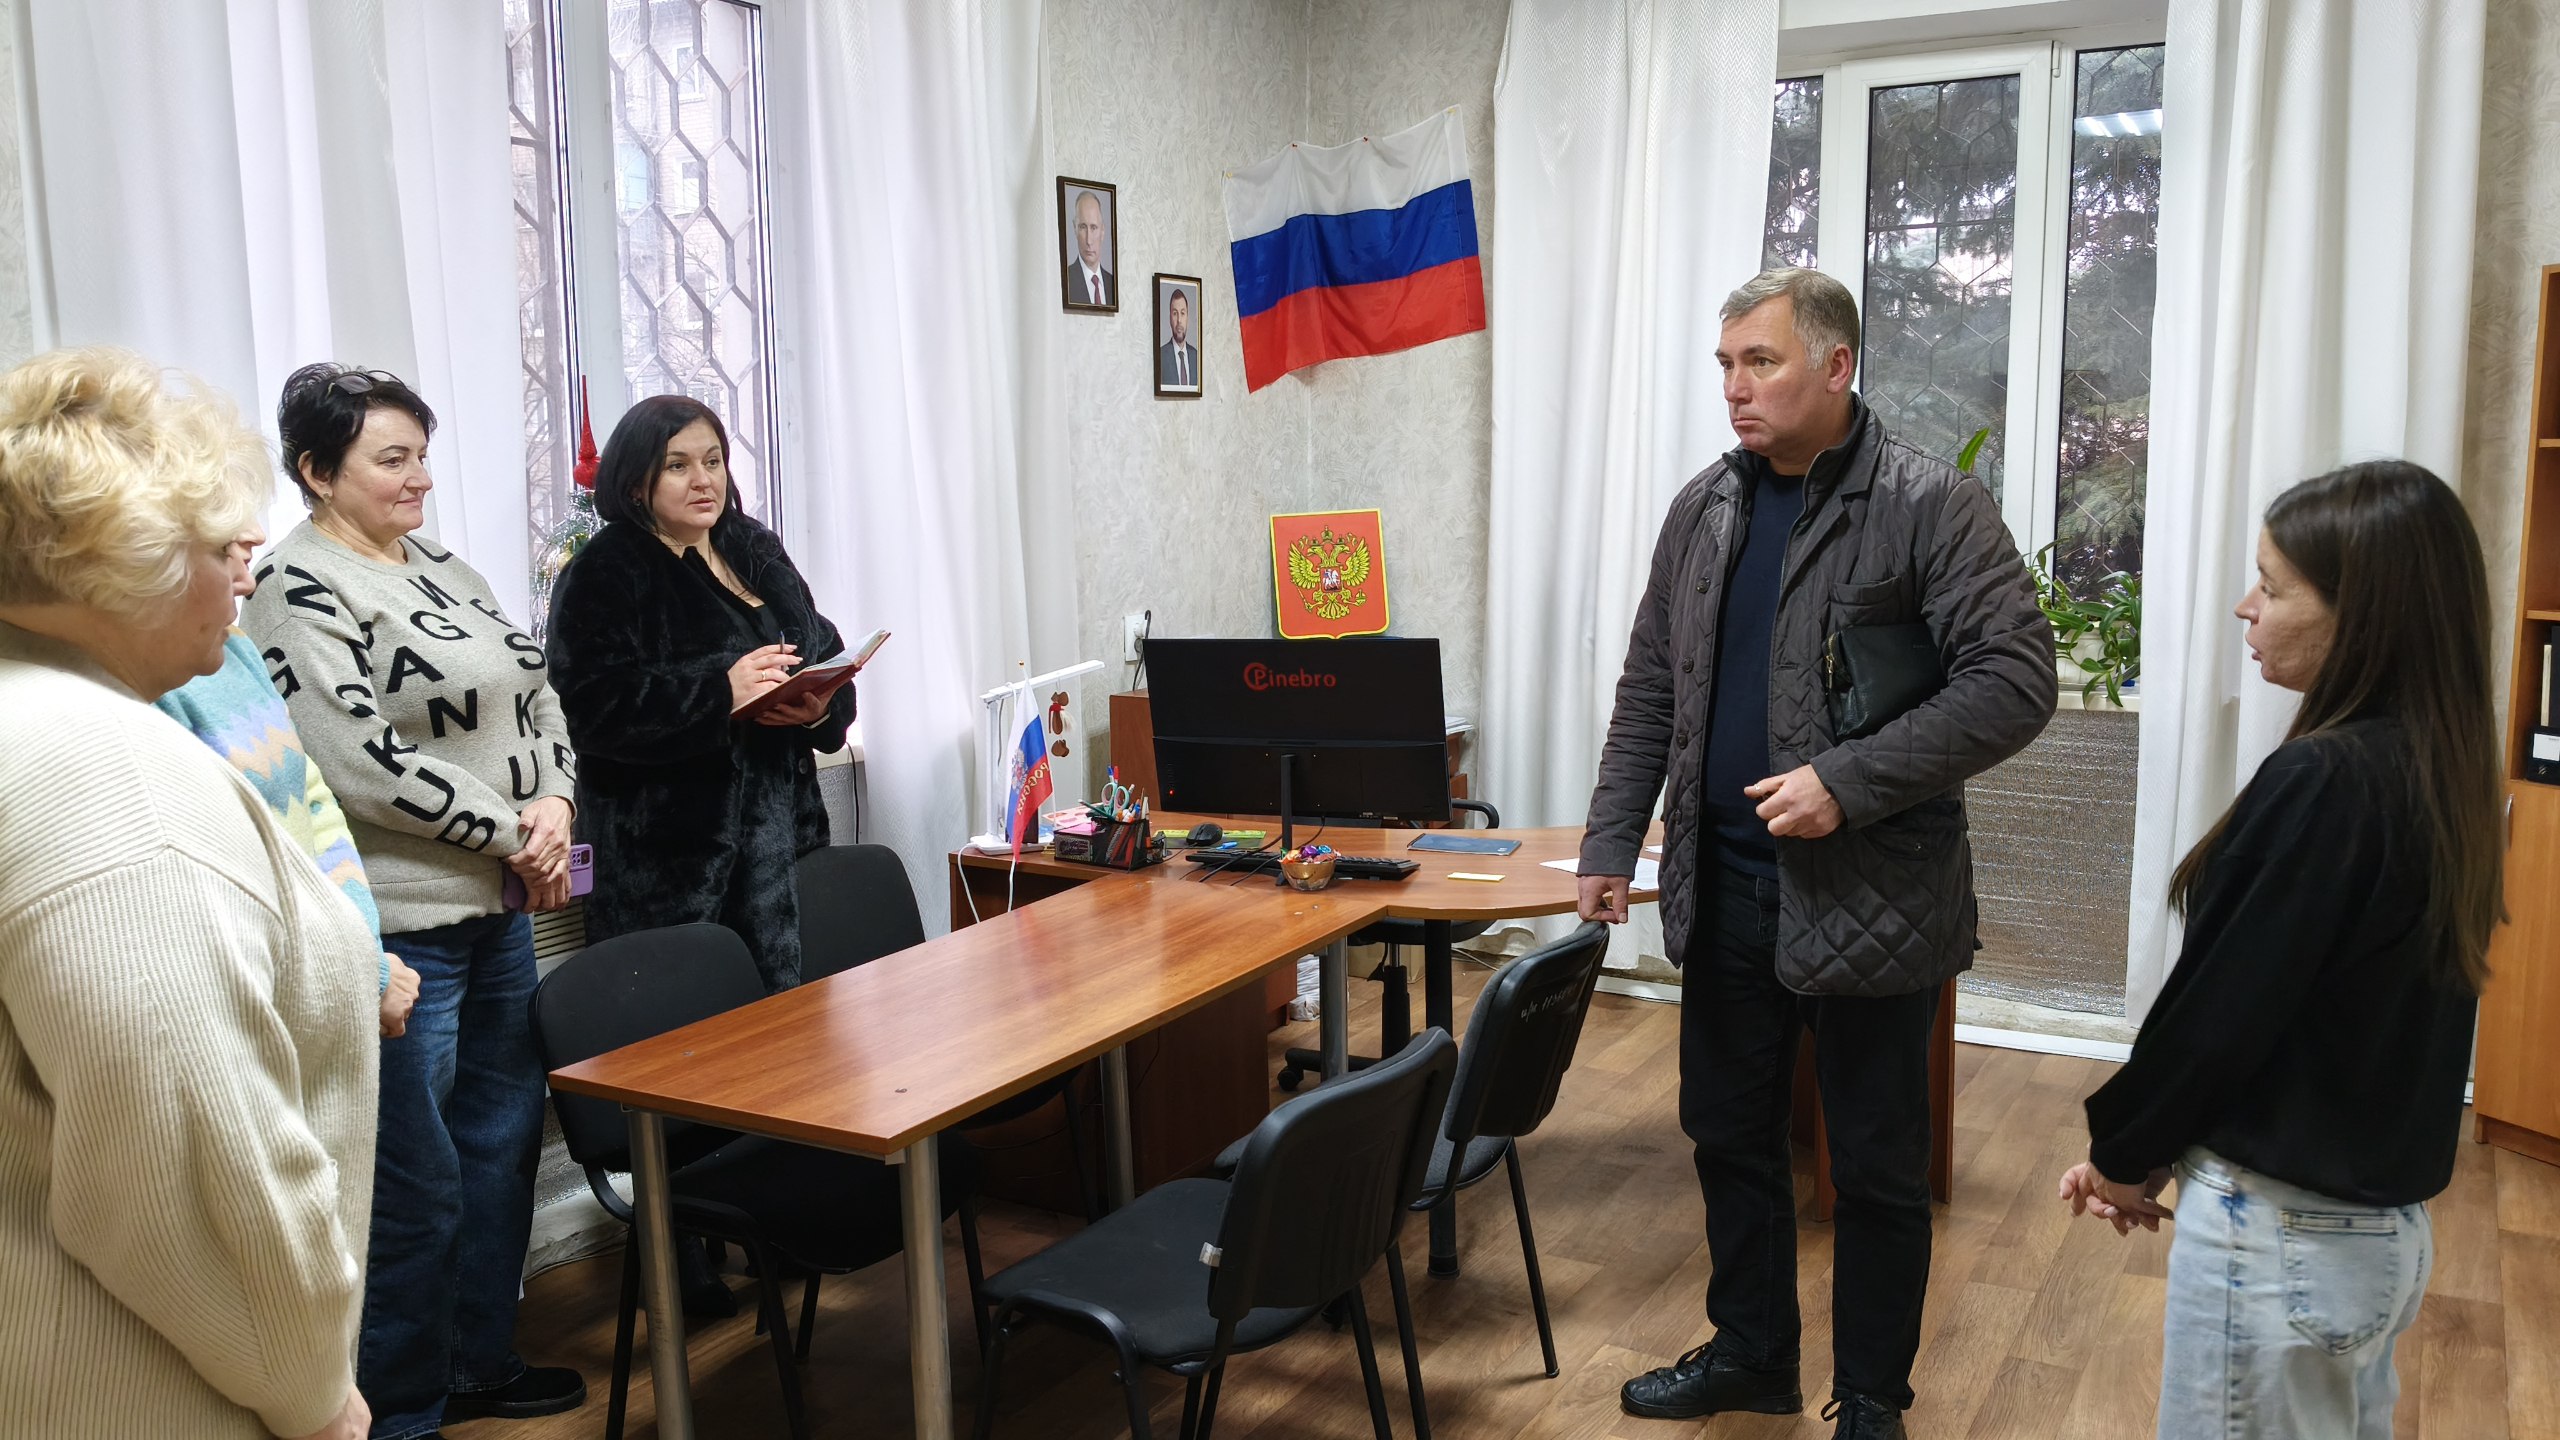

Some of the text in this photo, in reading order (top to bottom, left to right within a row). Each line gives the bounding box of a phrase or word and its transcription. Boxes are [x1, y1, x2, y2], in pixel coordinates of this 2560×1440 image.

[409, 610, 473, 640] G
[386, 645, 445, 693] A
[504, 632, 547, 671] S
[427, 688, 478, 739] N
[515, 688, 538, 739] K
[362, 724, 418, 778] K
[507, 749, 539, 801] U
[391, 766, 455, 823] U
[434, 810, 496, 853] B
